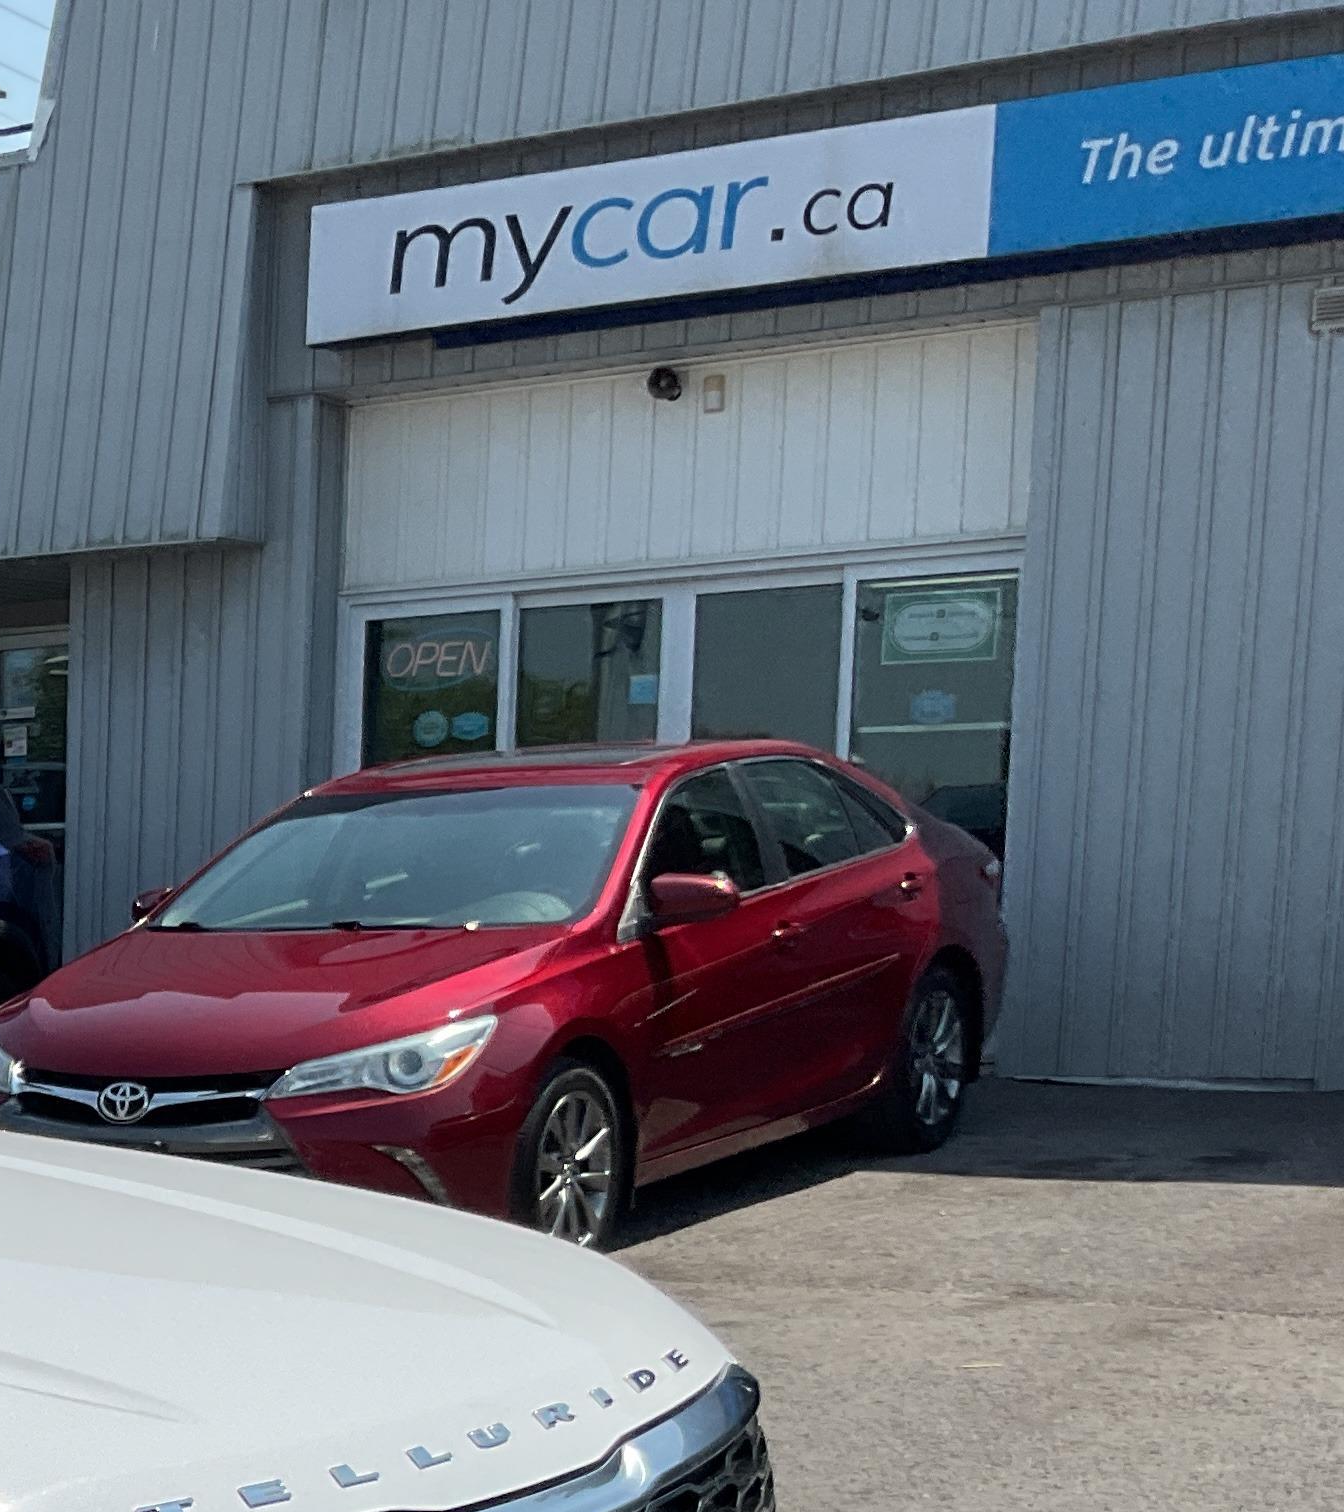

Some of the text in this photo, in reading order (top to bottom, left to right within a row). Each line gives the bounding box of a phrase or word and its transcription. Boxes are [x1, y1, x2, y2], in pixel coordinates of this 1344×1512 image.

[1080, 132, 1179, 184] The
[389, 175, 895, 305] mycar.ca
[386, 640, 491, 677] OPEN
